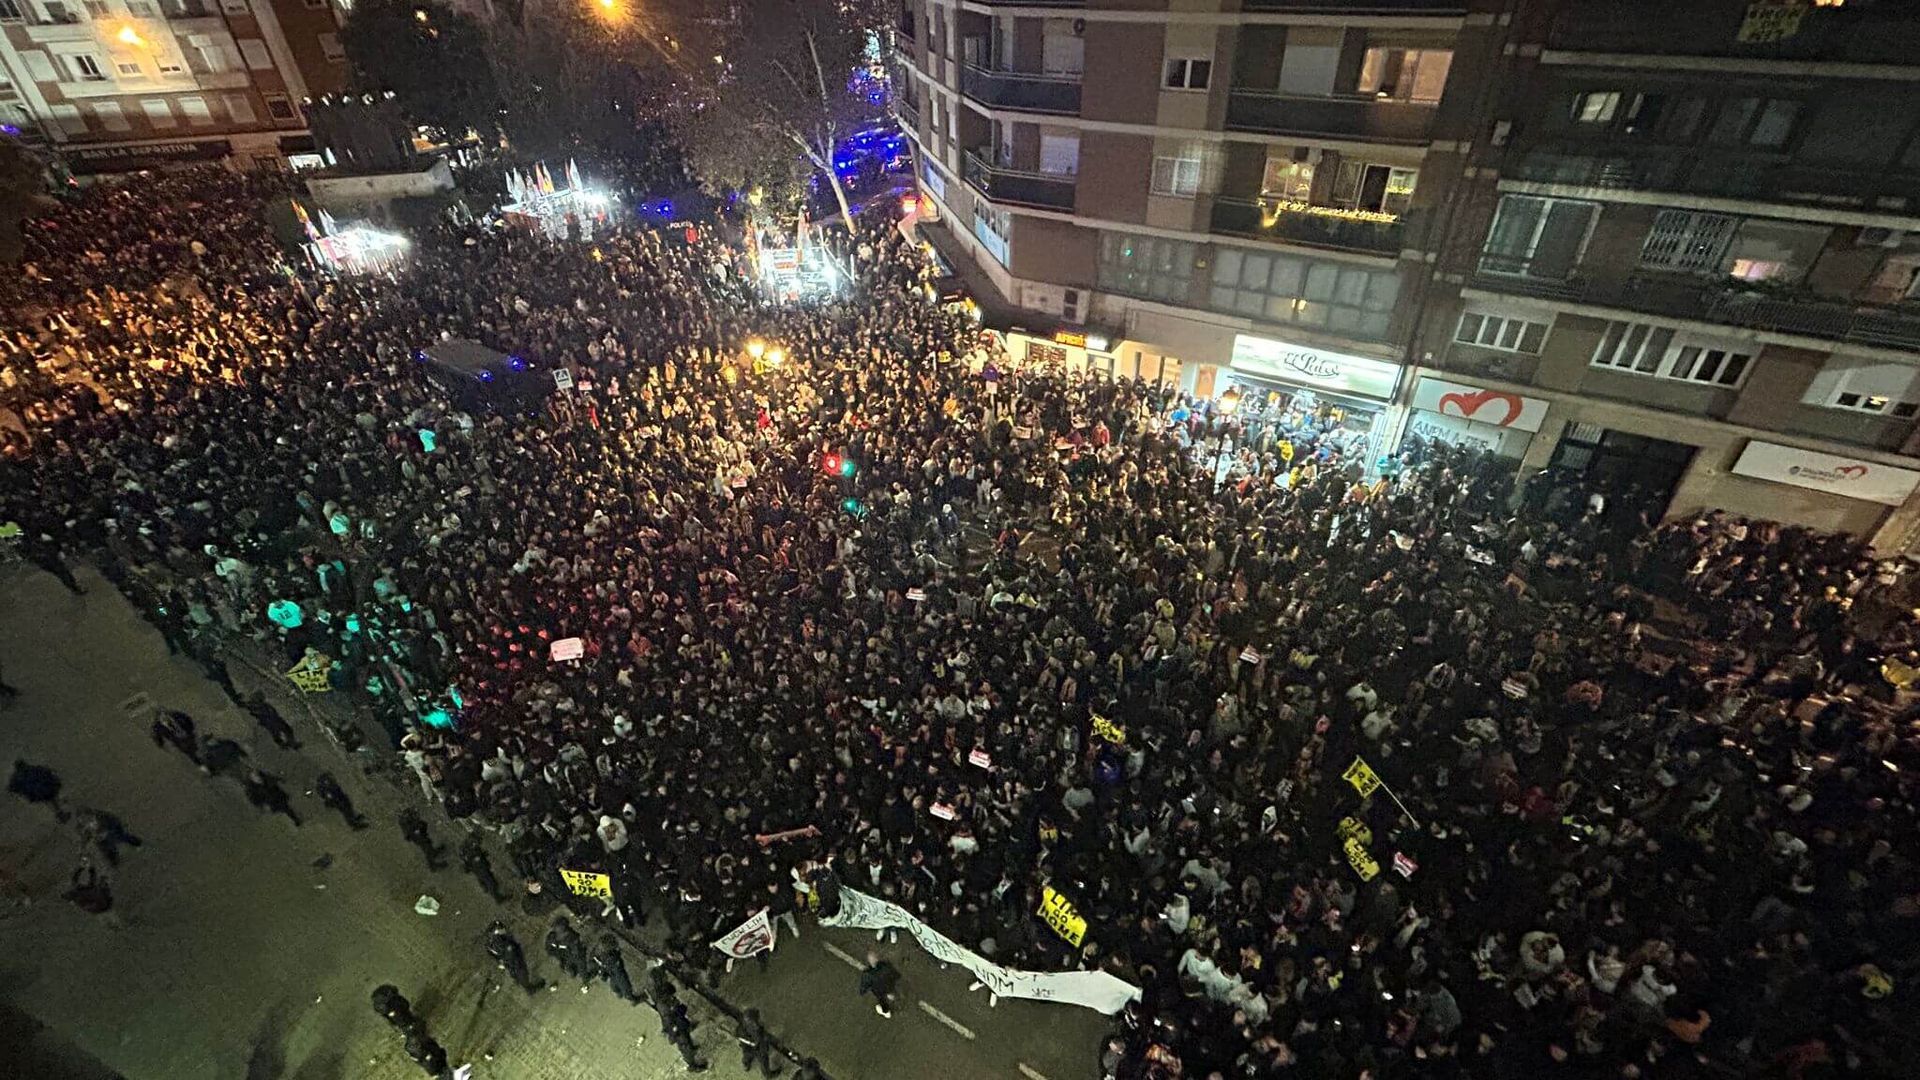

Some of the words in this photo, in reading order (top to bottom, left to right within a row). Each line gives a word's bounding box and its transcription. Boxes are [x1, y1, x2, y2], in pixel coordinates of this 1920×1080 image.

[567, 872, 597, 881] LIM
[570, 884, 608, 897] HOME
[1051, 892, 1078, 921] LIM
[1053, 909, 1068, 924] GO
[1040, 905, 1080, 944] HOME
